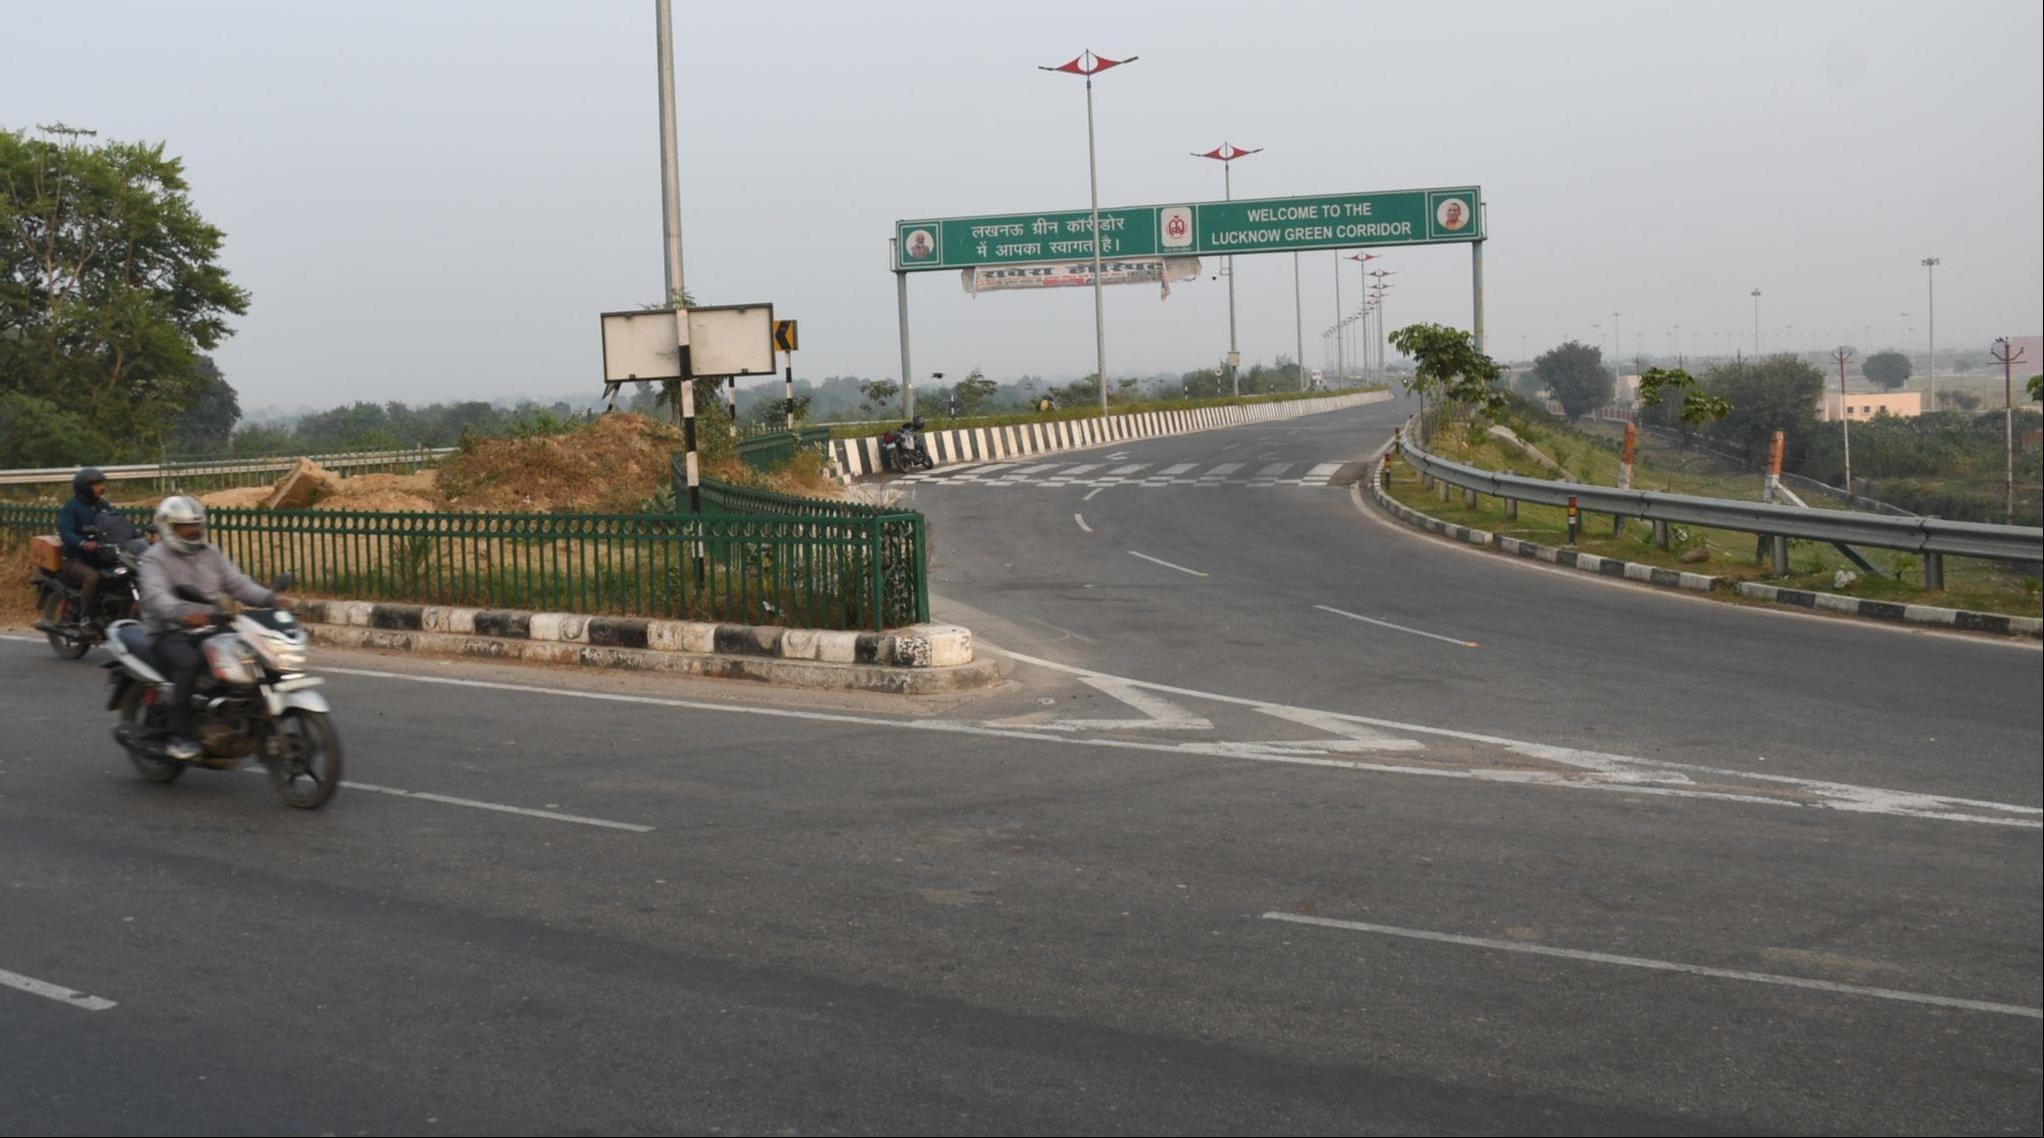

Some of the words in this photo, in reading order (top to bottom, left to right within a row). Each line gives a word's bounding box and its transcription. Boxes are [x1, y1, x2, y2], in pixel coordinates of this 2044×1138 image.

[1248, 206, 1317, 222] WELCOME
[1321, 204, 1340, 218] TO
[1343, 202, 1372, 217] THE
[972, 224, 1024, 239] लखनऊ
[1031, 217, 1059, 235] ग्रीन
[1212, 228, 1281, 245] LUCKNOW
[1284, 225, 1333, 242] GREEN
[1336, 222, 1411, 239] CORRIDOR
[977, 241, 988, 257] में
[995, 242, 1041, 257] आपका
[1049, 240, 1094, 254] स्वागत
